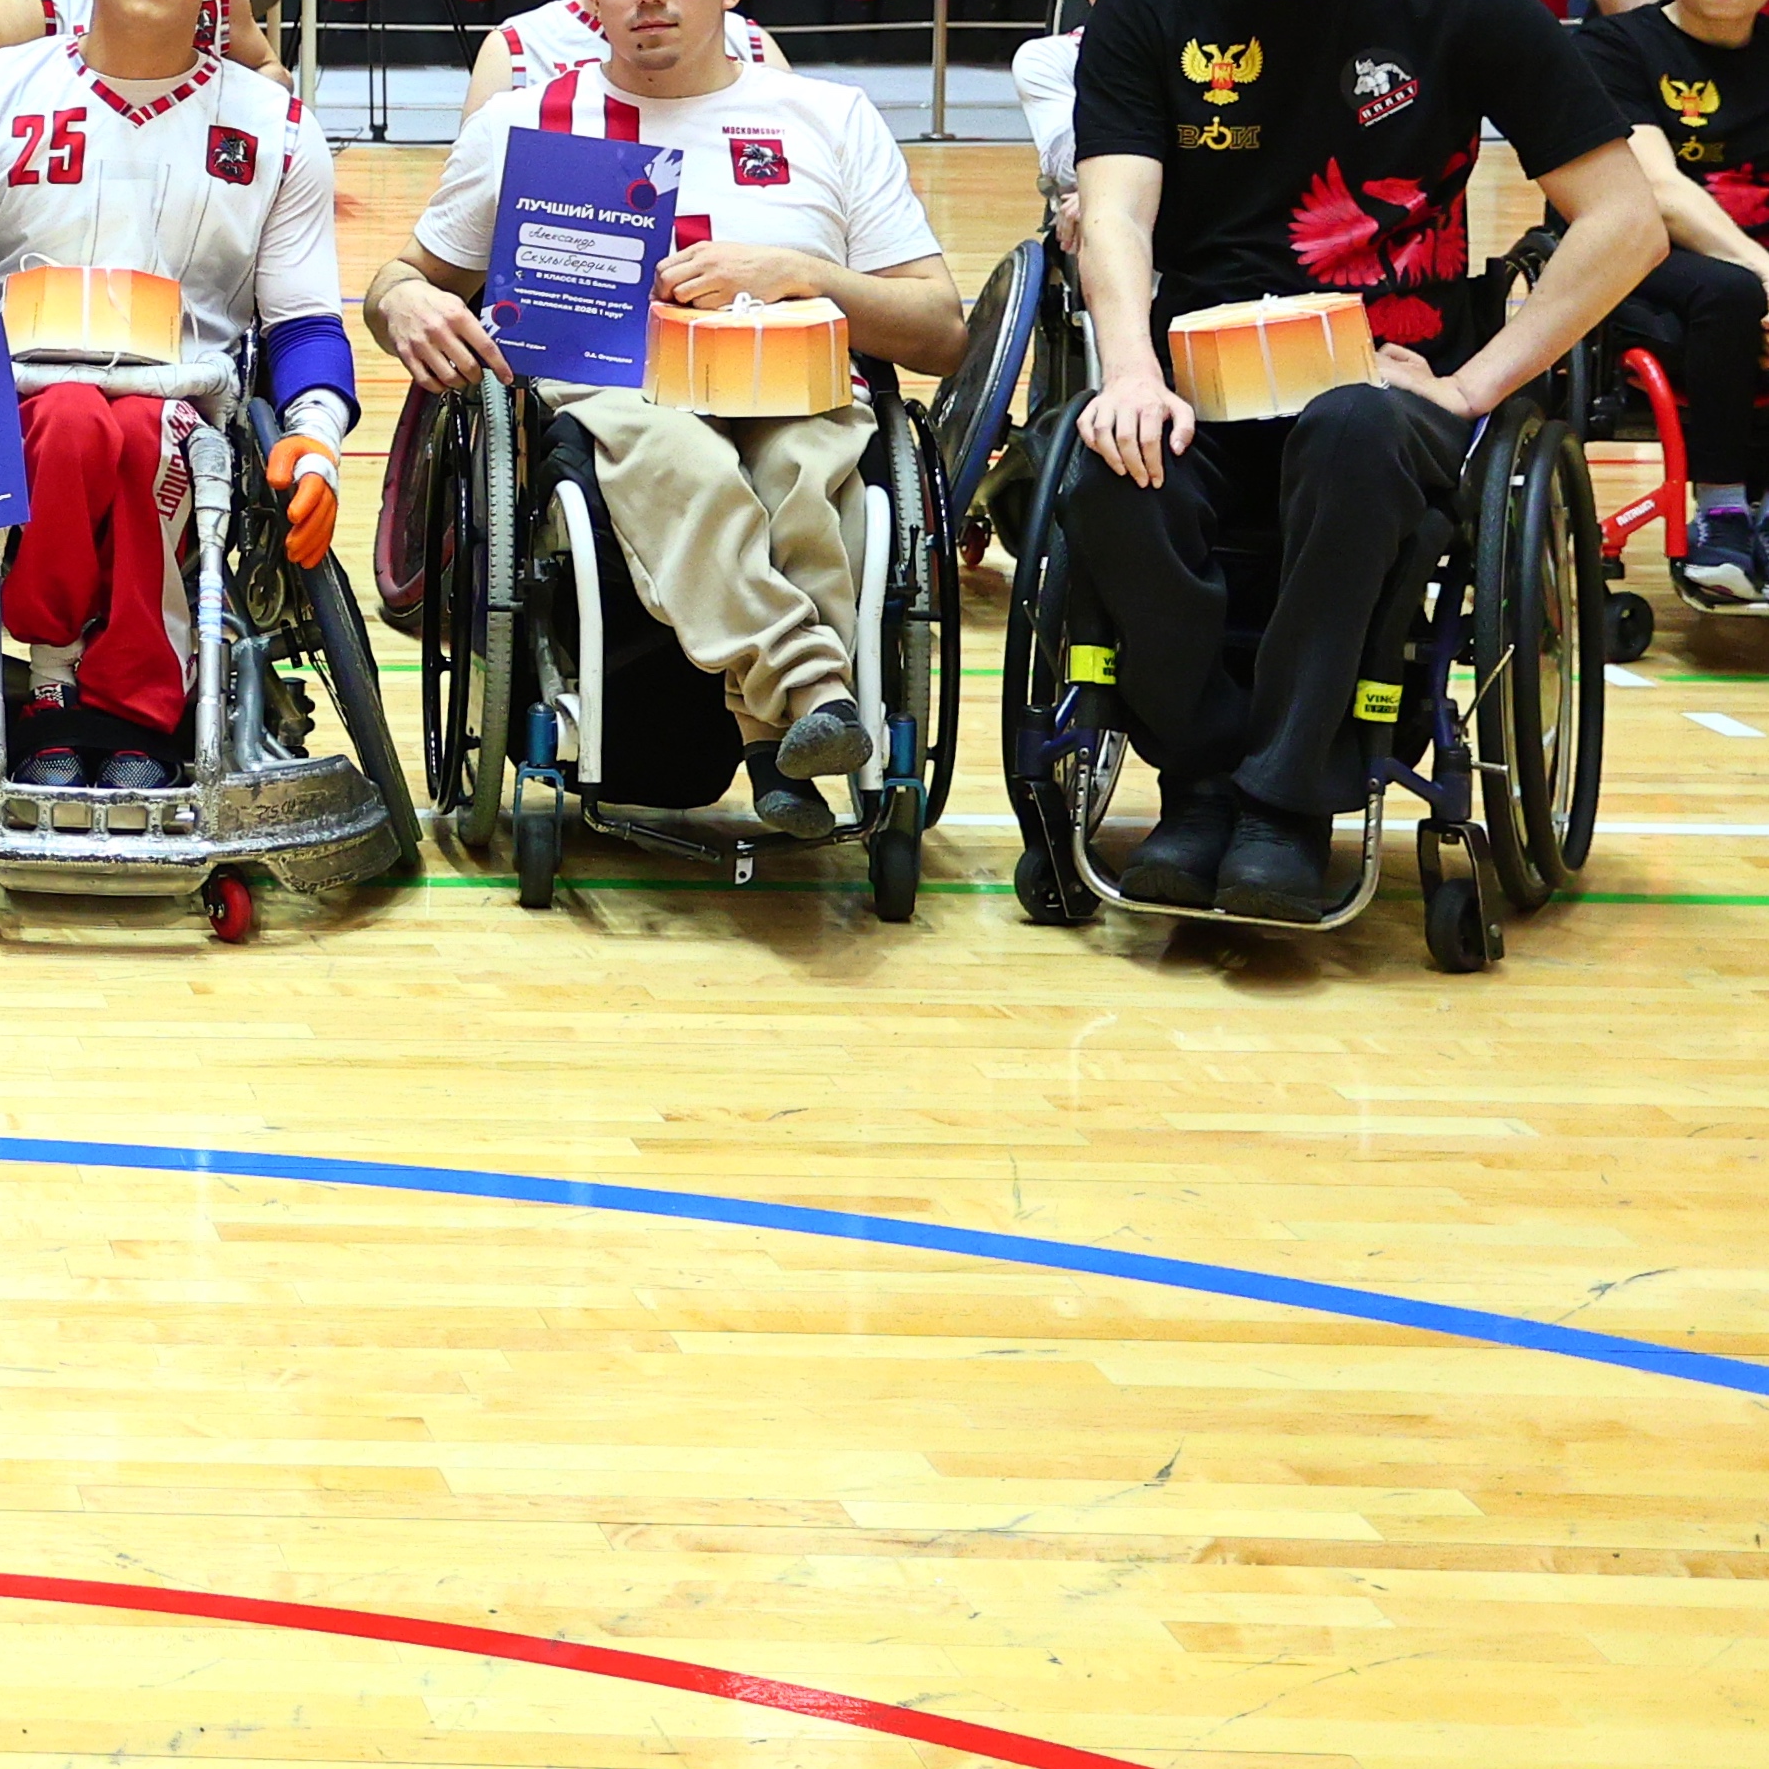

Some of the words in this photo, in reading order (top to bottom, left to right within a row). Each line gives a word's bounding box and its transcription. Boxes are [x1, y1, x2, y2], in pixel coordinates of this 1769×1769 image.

[722, 126, 786, 135] МОСКОМСПОРТ
[8, 106, 88, 187] 25
[516, 197, 595, 220] ЛУЧШИЙ
[597, 209, 656, 229] ИГРОК
[529, 227, 596, 251] Александр
[543, 273, 577, 284] КЛАССЕ
